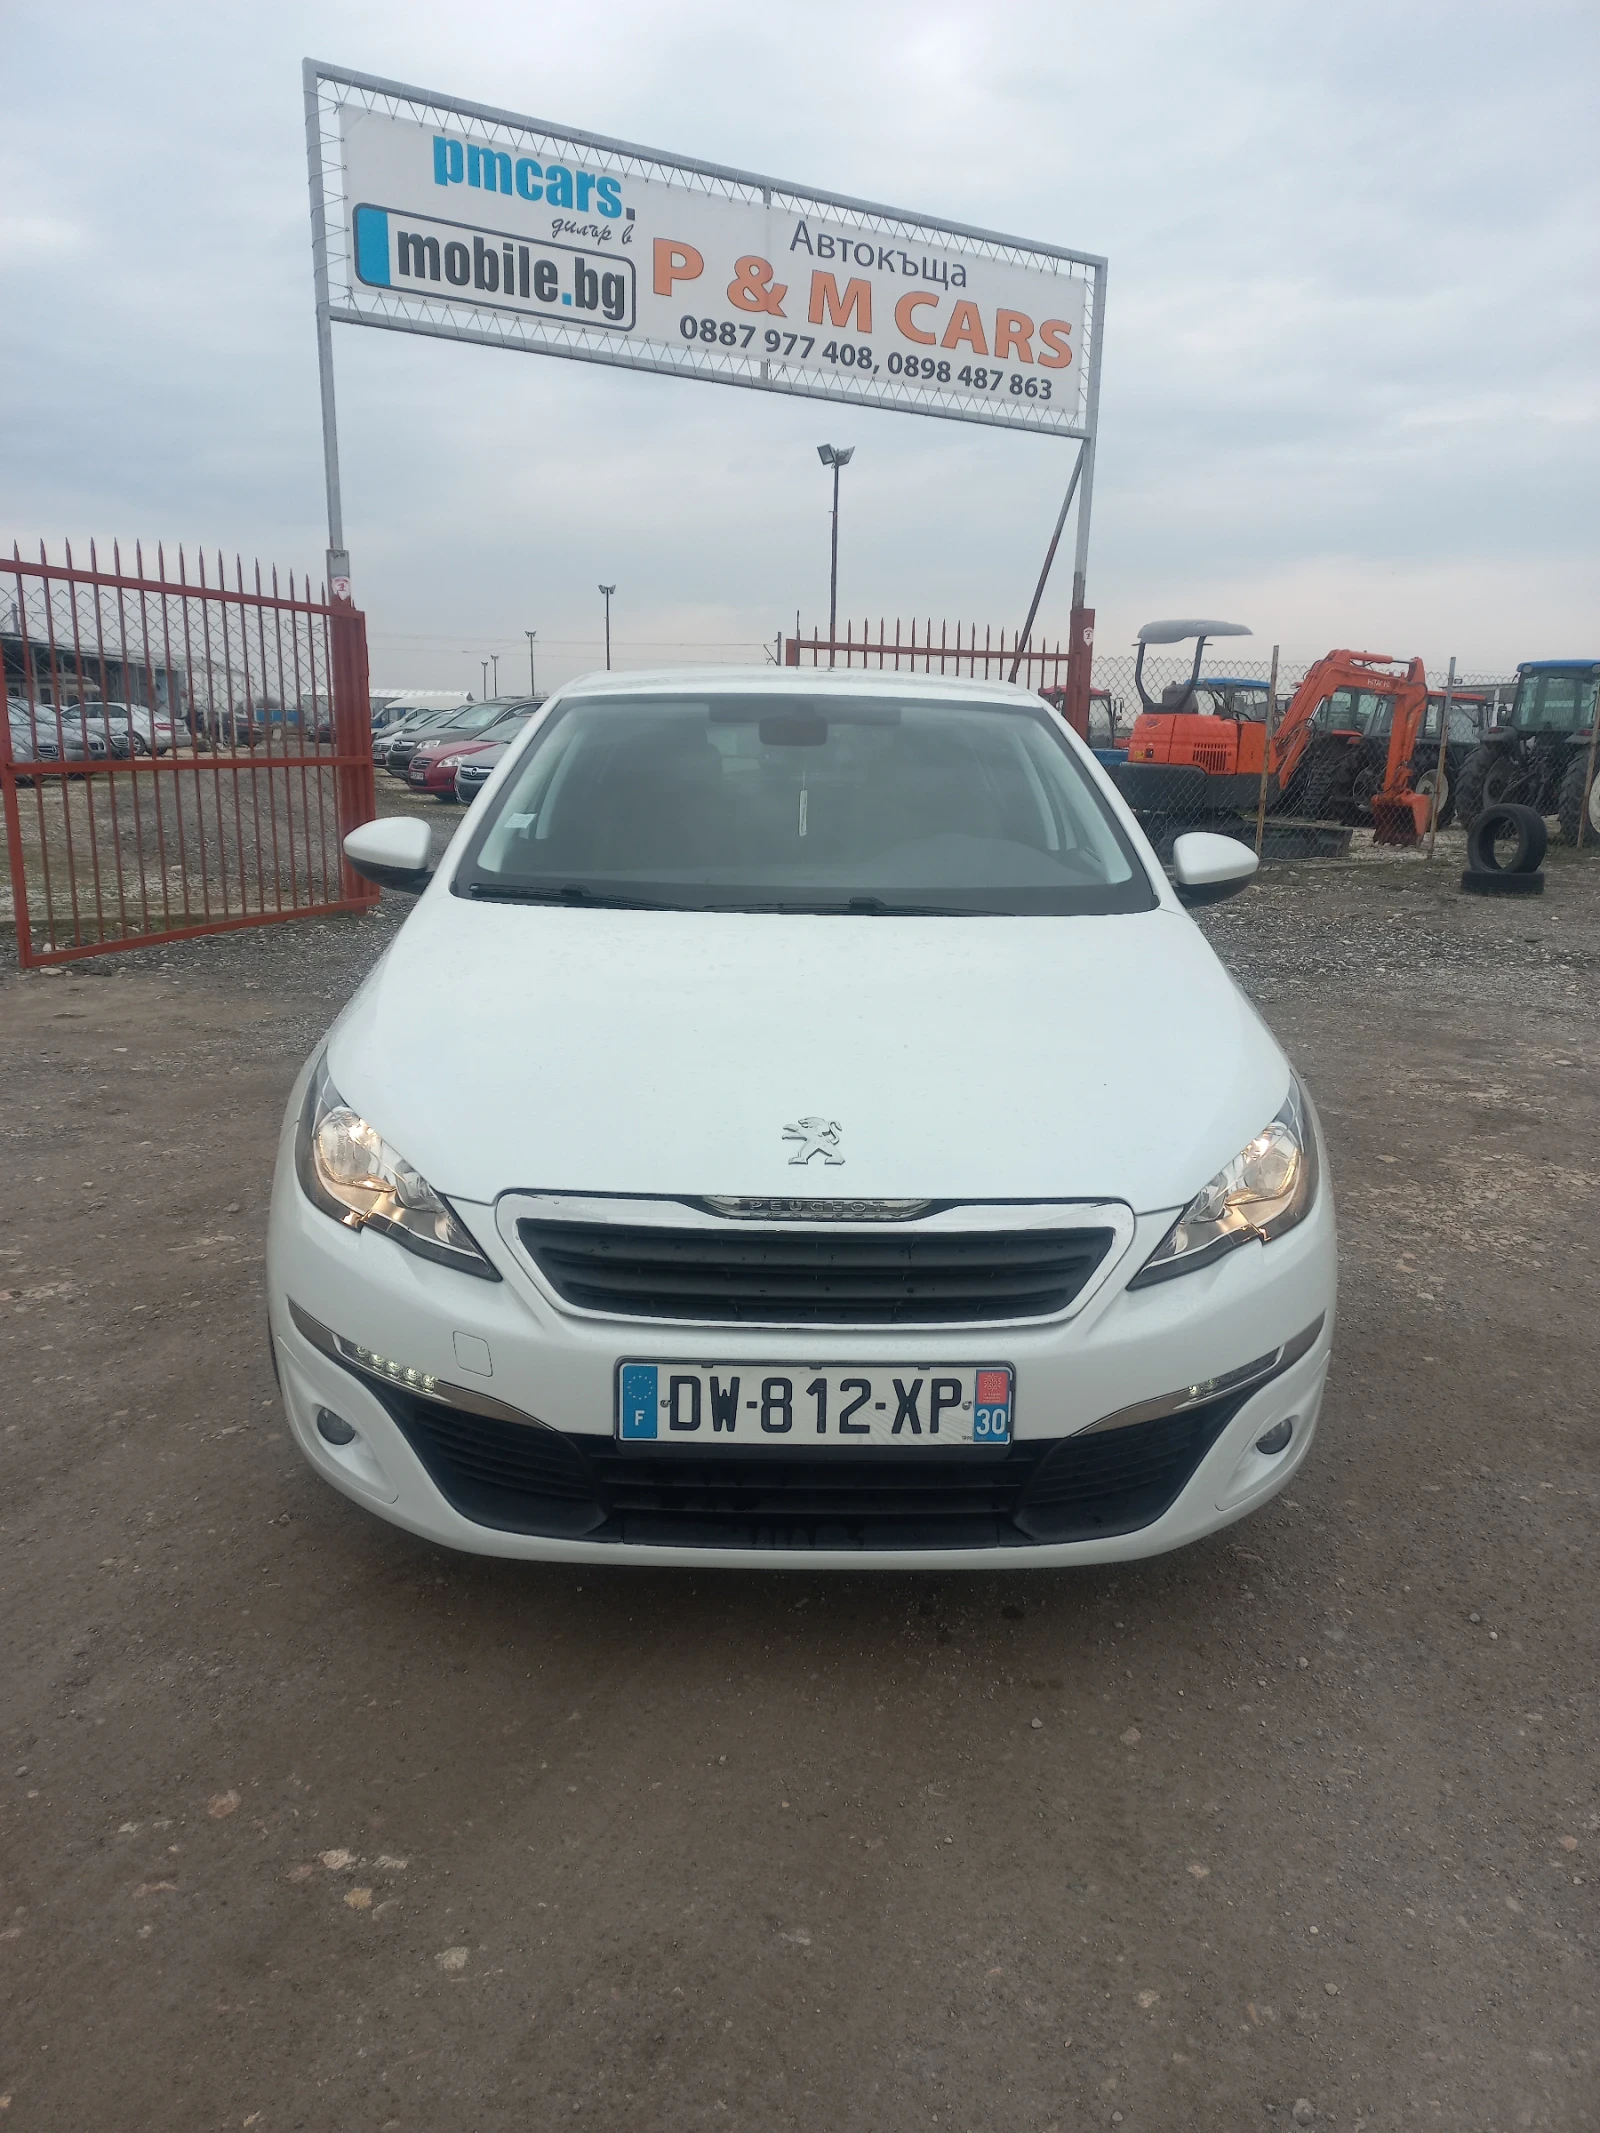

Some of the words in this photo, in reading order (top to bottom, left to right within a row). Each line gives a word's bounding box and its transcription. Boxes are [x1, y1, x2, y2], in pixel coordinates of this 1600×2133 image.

[432, 135, 636, 221] pmcars.
[551, 218, 613, 246] дилър
[621, 223, 635, 245] в
[789, 219, 967, 288] Автокъща
[397, 230, 625, 322] mobile.bg
[652, 236, 704, 297] P
[726, 254, 789, 318] &
[807, 269, 873, 334] M
[894, 290, 1073, 369] CARS
[679, 314, 757, 349] 0887
[764, 328, 816, 359] 977
[821, 340, 880, 375] 408,
[886, 351, 952, 383] 0898
[957, 364, 1004, 391] 487
[1008, 375, 1053, 401] 863
[749, 1200, 885, 1212] PEUGEOT
[634, 1409, 646, 1426] F
[669, 1375, 963, 1434] DW-812-XP
[976, 1408, 1006, 1435] 30
